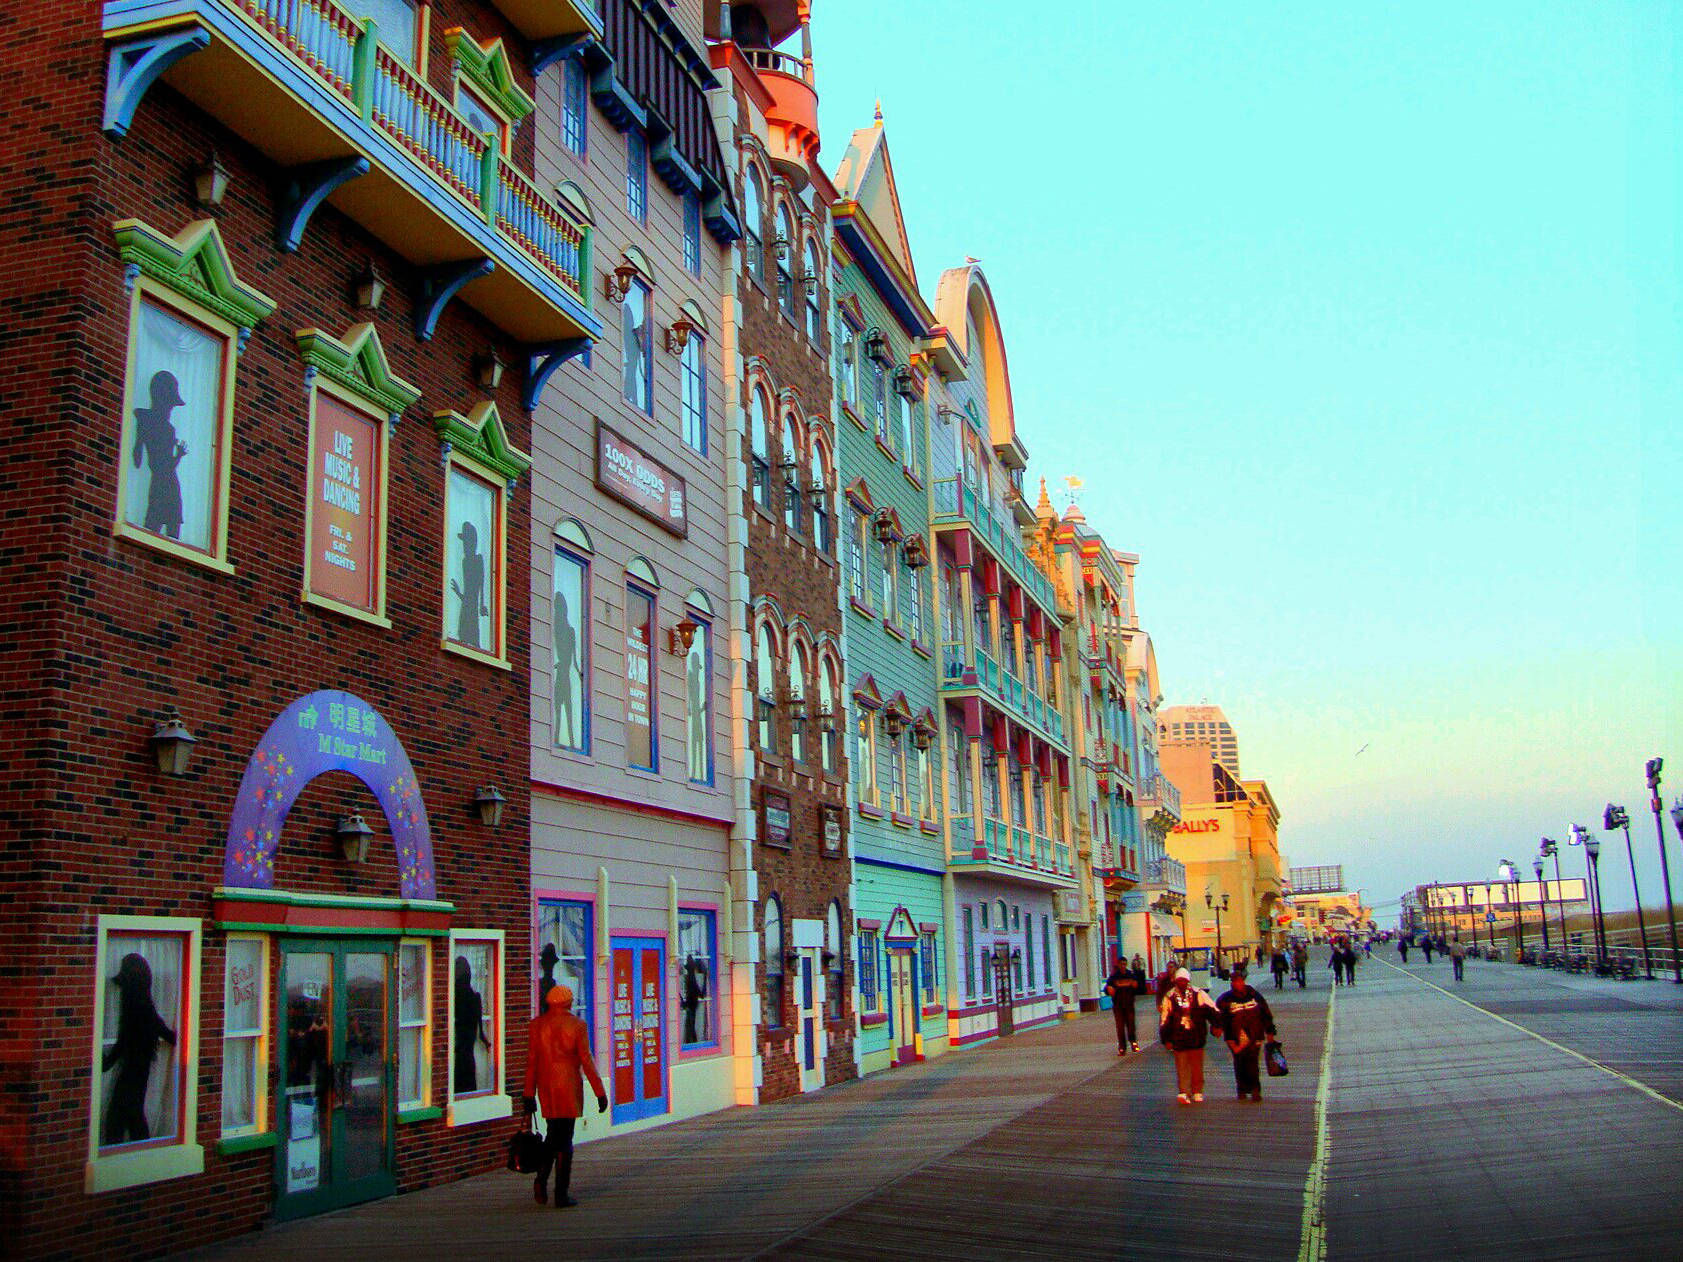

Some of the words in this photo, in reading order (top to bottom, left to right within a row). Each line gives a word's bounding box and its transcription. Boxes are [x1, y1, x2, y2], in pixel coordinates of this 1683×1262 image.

[334, 430, 353, 460] LIVE
[324, 451, 352, 486] MUSIC
[352, 465, 360, 489] &
[605, 443, 634, 474] 100X
[636, 463, 666, 495] ODDS
[323, 477, 360, 515] DANCING
[324, 549, 356, 572] NIGHTS
[627, 652, 637, 680] 24
[318, 732, 332, 754] M
[333, 736, 358, 759] Star
[359, 742, 387, 766] Mart
